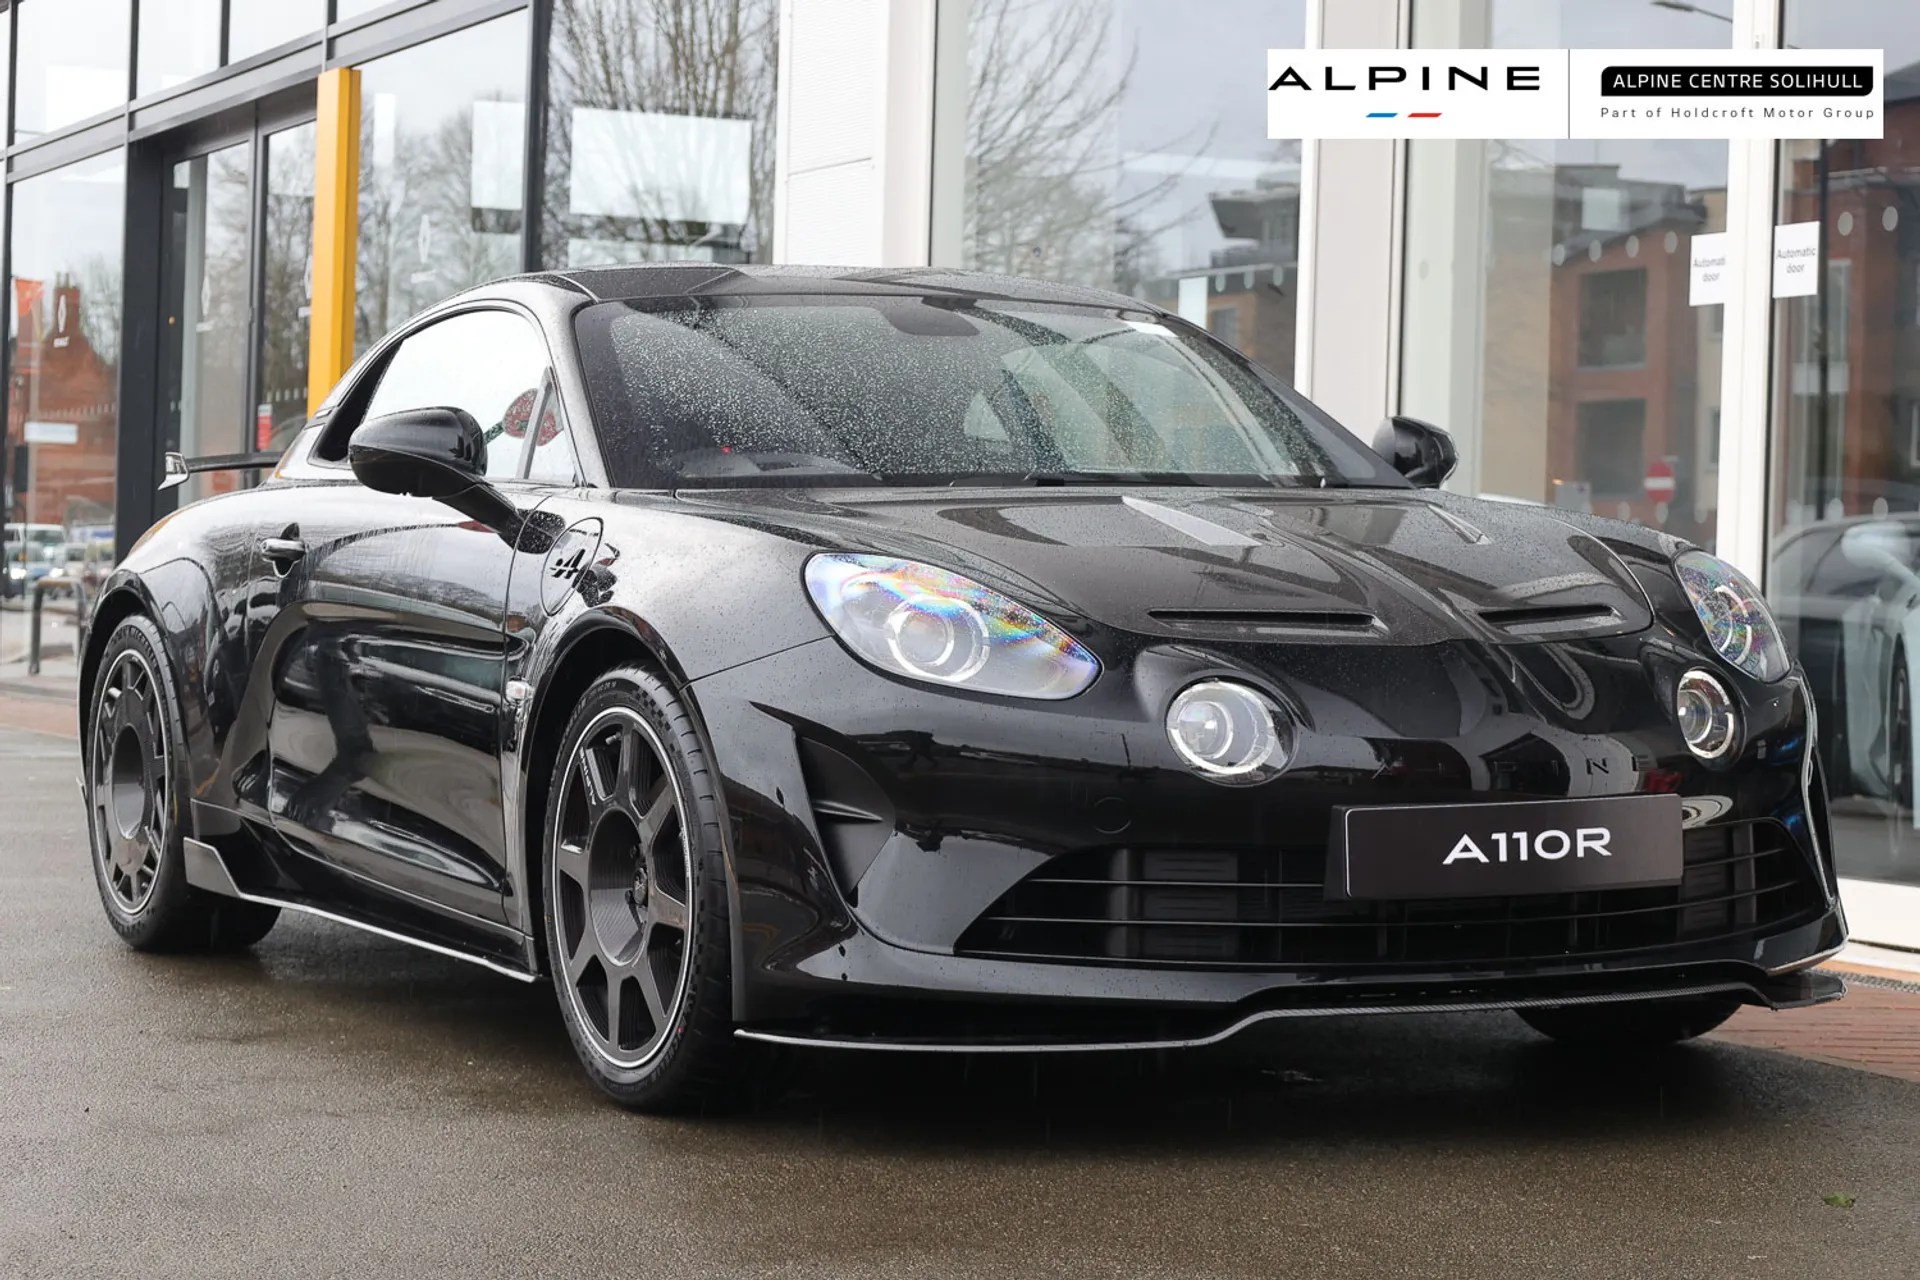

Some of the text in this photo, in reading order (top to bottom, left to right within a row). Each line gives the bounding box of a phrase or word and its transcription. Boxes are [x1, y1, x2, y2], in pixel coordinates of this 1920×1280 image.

[1776, 246, 1816, 259] Automatic
[1693, 257, 1726, 268] Automati
[1786, 264, 1805, 274] door
[1442, 827, 1612, 865] A110R
